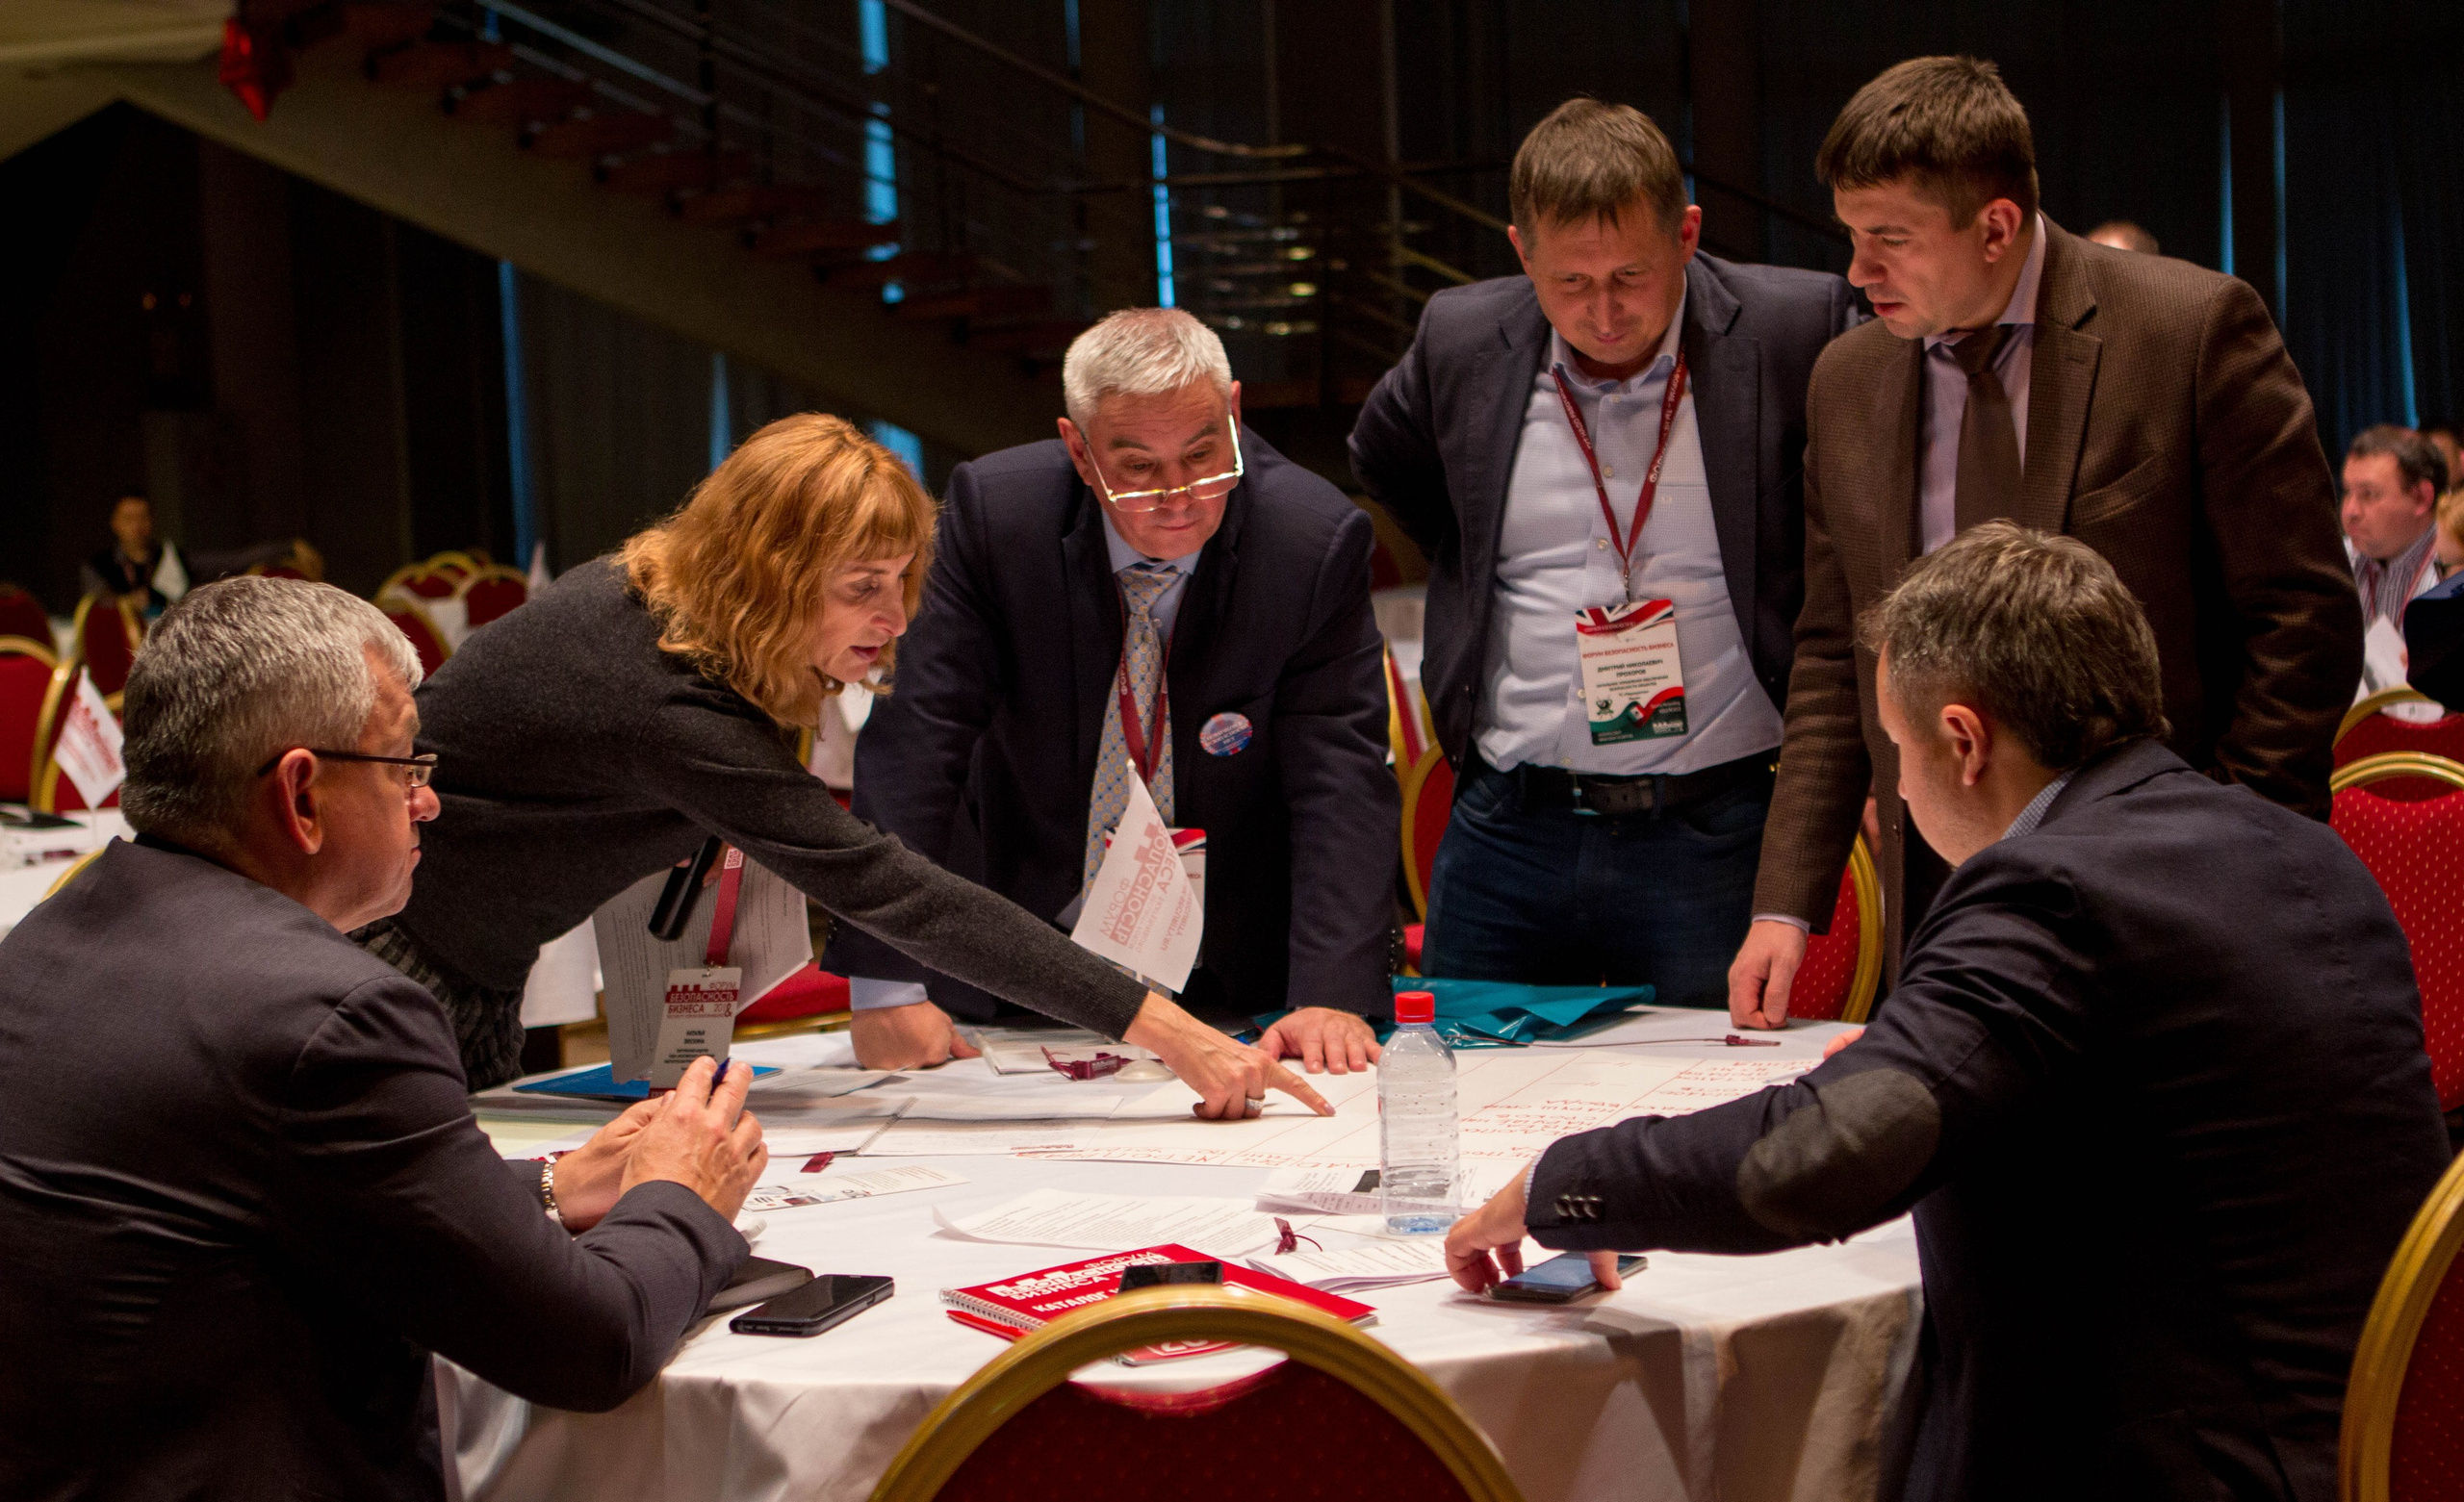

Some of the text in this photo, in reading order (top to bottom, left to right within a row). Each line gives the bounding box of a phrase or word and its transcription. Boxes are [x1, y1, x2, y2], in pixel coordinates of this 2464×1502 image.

[1573, 418, 1588, 438] НАДО
[1604, 646, 1648, 656] БЕЗОПАСНОСТЬ
[1649, 642, 1675, 651] БИЗНЕСА
[1598, 659, 1664, 673] ДМИТРИЙ НИКОЛАЕВИЧ
[1616, 669, 1646, 677] ПРОХОРОВ
[709, 981, 737, 991] ФОРУМ
[670, 991, 735, 1003] БЕЗОПАСНОСТЬ
[668, 1004, 705, 1014] БИЗНЕСА
[1085, 1251, 1160, 1269] ФОРУМ
[998, 1254, 1171, 1296] БЕЗОПАСНОСТЬ
[1011, 1276, 1110, 1301] БИЗНЕСА
[1032, 1290, 1113, 1312] КАТАЛОГ
